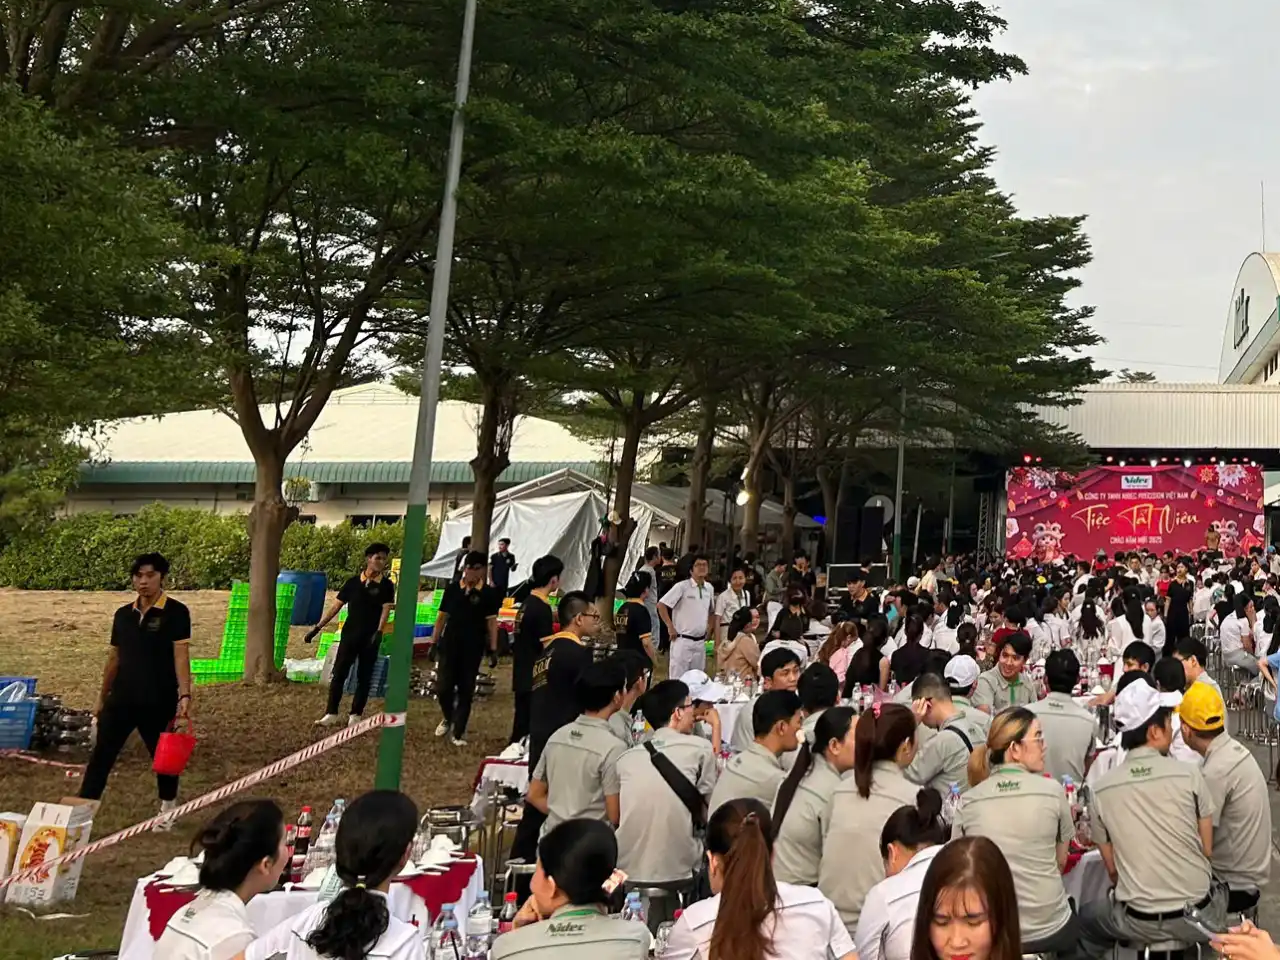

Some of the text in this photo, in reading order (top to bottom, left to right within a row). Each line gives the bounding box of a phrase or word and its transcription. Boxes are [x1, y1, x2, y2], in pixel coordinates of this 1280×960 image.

[1071, 503, 1199, 534] Tiệc Tất Niên
